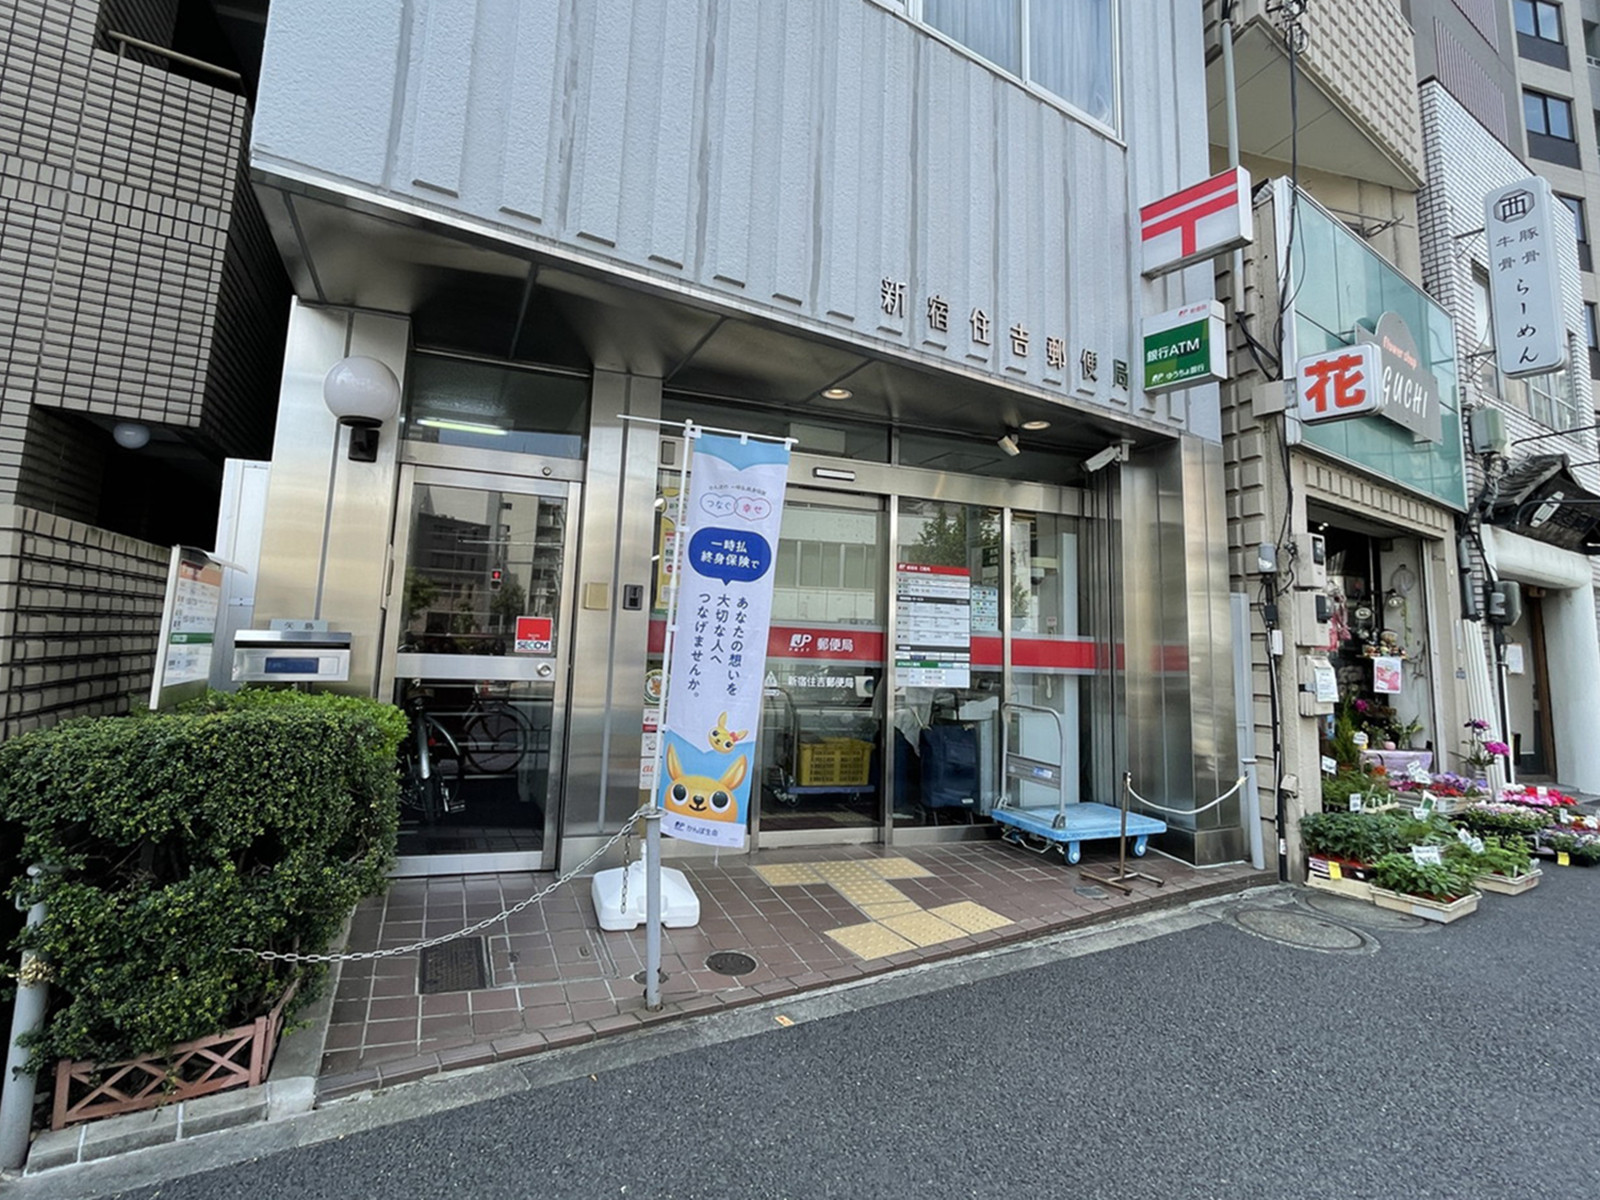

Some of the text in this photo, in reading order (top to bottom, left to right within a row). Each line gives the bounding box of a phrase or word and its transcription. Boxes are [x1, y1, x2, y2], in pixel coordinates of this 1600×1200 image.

[1496, 235, 1516, 271] 牛骨
[1519, 226, 1540, 266] 豚骨
[881, 276, 1128, 391] 新宿住吉郵便局
[1516, 278, 1539, 364] らーめん
[1147, 337, 1200, 363] 銀行ATM
[1166, 363, 1204, 380] ゆうちょ銀行
[1304, 354, 1366, 413] 花
[707, 500, 731, 510] つなぐ
[700, 551, 760, 569] 終身保険で
[711, 539, 747, 553] 一時払
[687, 593, 711, 698] つなげませんか。
[710, 594, 730, 664] 大切な人へ
[725, 597, 748, 697] あなたの想いを
[817, 637, 854, 652] 郵便局
[788, 675, 854, 688] 新宿住吉郵便局
